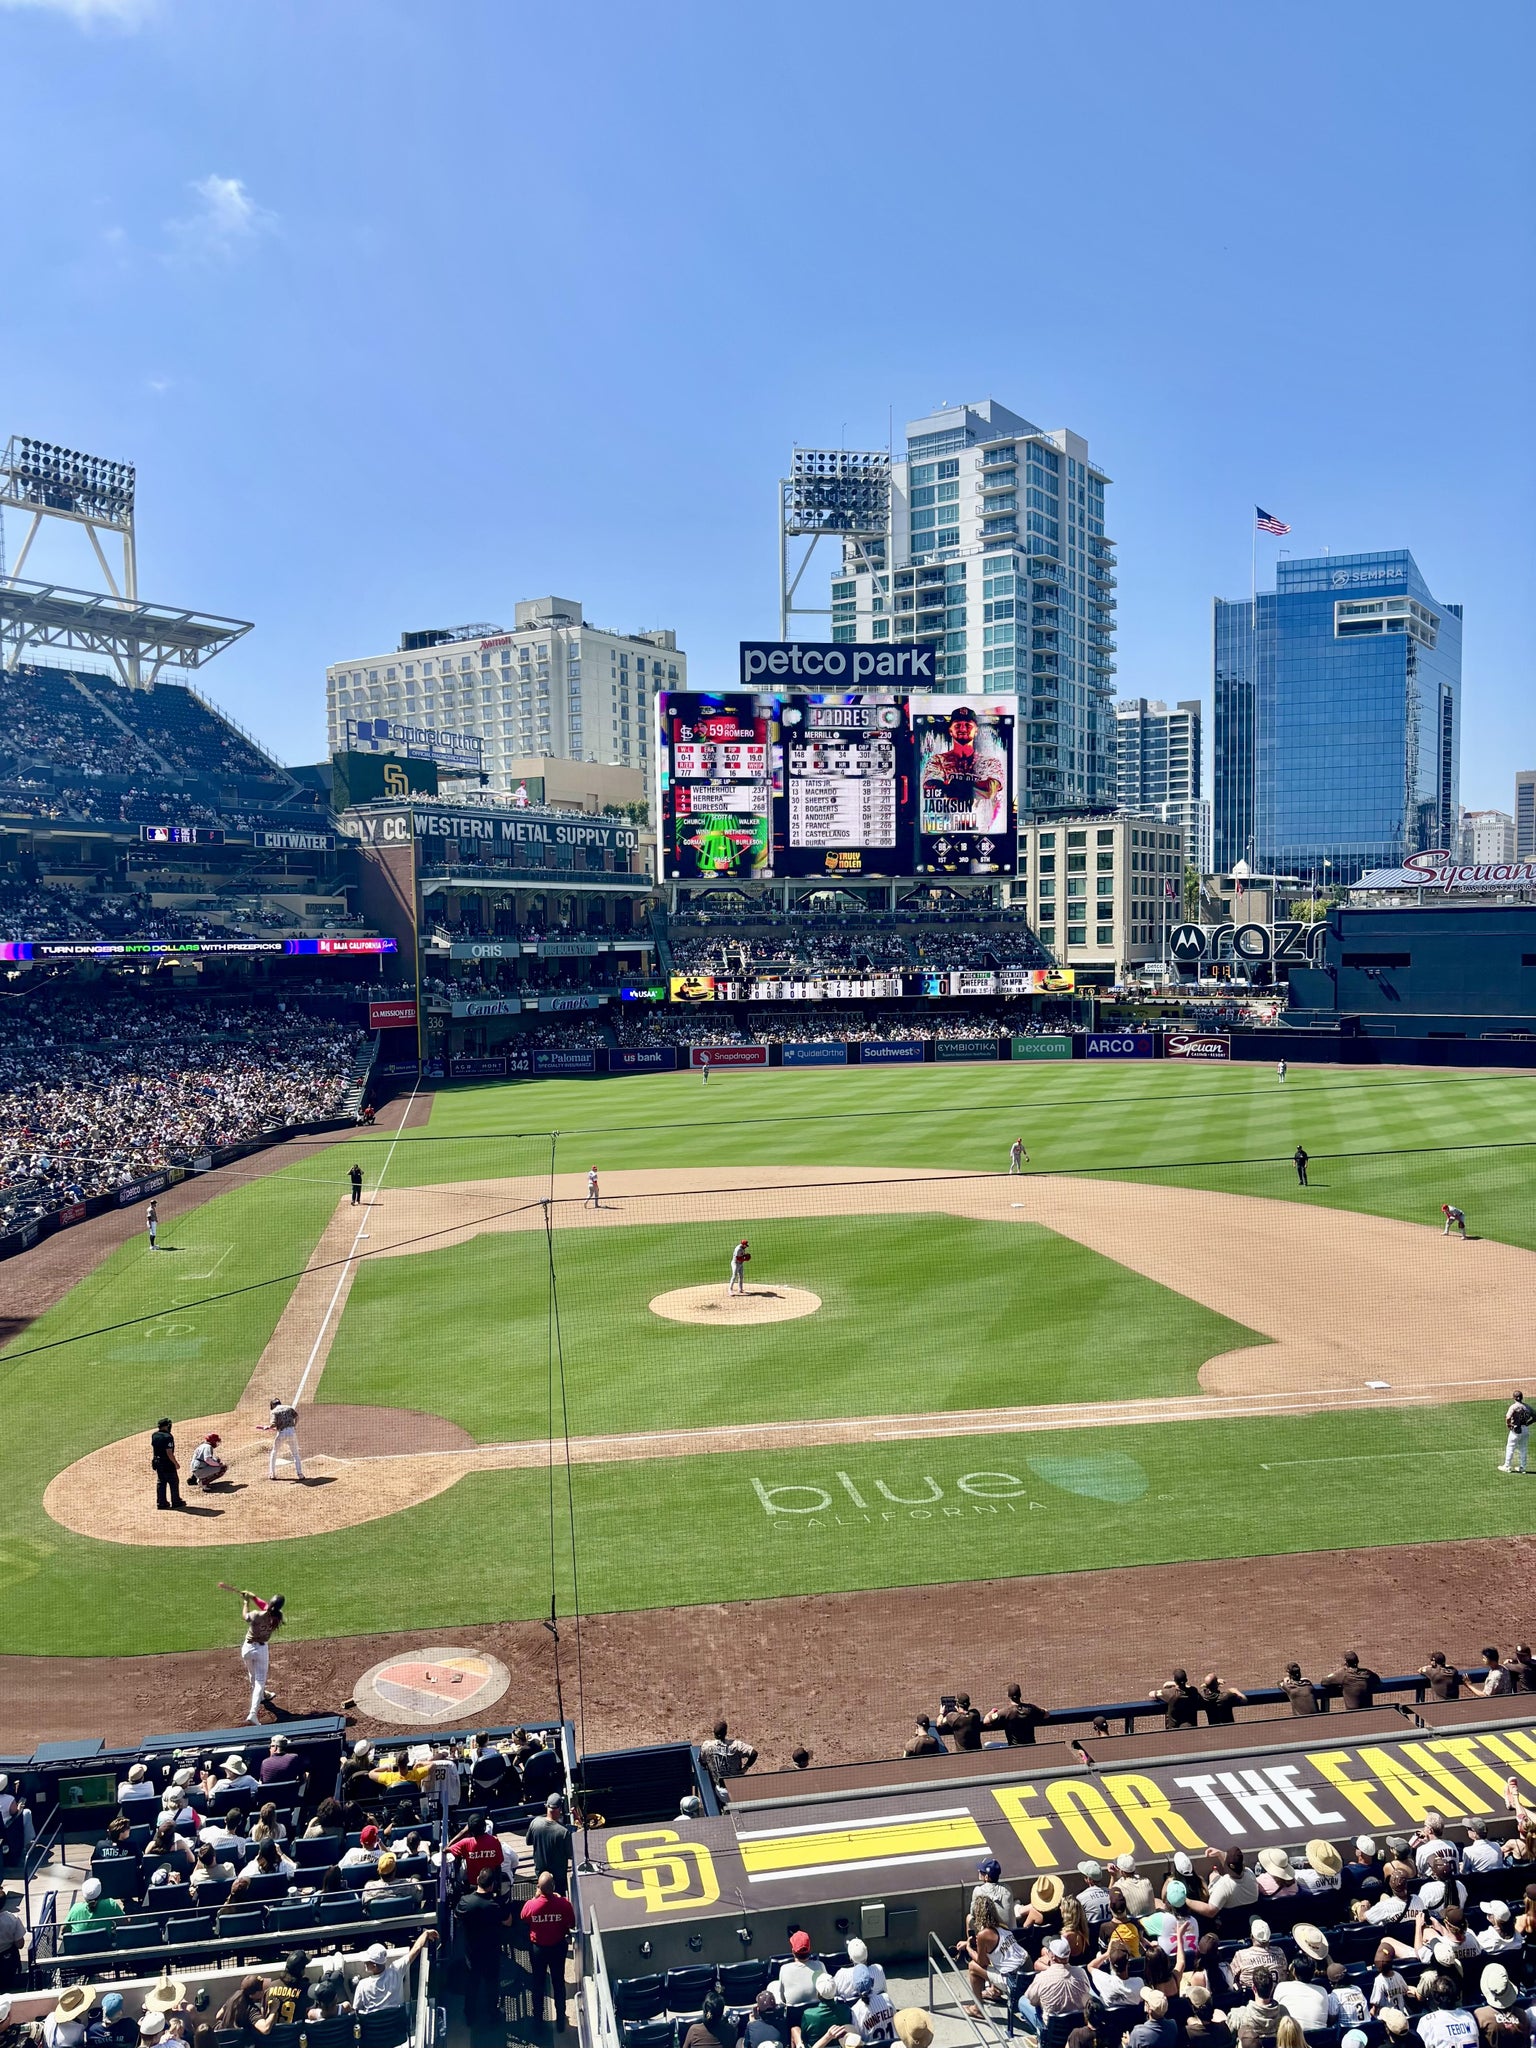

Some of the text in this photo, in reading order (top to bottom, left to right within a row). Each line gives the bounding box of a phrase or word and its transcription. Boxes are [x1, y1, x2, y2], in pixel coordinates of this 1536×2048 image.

[1352, 569, 1404, 582] SEMPRA
[744, 644, 931, 683] petco park
[815, 709, 869, 726] PADRES
[709, 724, 723, 737] 59
[393, 724, 480, 751] QuidelOrtho
[934, 789, 942, 797] CF
[923, 799, 973, 813] JACKSON
[383, 817, 410, 840] CO.
[413, 814, 638, 849] WESTERN METAL SUPPLY CO.
[264, 833, 327, 849] CUTWATER
[838, 852, 861, 860] TRULY
[838, 860, 862, 868] NOLEN
[1401, 849, 1536, 894] Sycuan
[1458, 884, 1496, 893] CASINO
[333, 942, 348, 950] BAJA
[350, 941, 381, 949] CALIFORNIA
[1211, 921, 1332, 961] razr
[41, 946, 74, 954] TURN
[152, 944, 199, 952] DOLLARS
[201, 943, 226, 951] WITH
[471, 945, 502, 957] ORIS
[923, 980, 946, 994] 2 0
[638, 990, 656, 998] USAA
[466, 1001, 509, 1016] Canel's
[551, 996, 589, 1011] Canel's
[428, 1016, 444, 1028] 336
[864, 1047, 914, 1057] Southwest
[937, 1043, 996, 1051] CYMBIOTIKA
[1088, 1040, 1134, 1053] ARCO
[1168, 1036, 1224, 1057] Sycuan
[551, 1053, 591, 1063] Palomar
[623, 1052, 662, 1062] us bank
[714, 1052, 760, 1062] Snapdragon
[797, 1049, 844, 1058] QuidelOrtho
[511, 1060, 529, 1071] 342
[150, 1177, 165, 1189] petco
[126, 1186, 141, 1198] petco
[749, 1470, 1028, 1516] blue
[773, 1501, 1048, 1530] CALIFORNIA
[435, 1768, 446, 1781] 23
[992, 1774, 1209, 1869] FOR
[1173, 1764, 1347, 1836] THE
[102, 1848, 118, 1857] TATIS
[468, 1850, 496, 1860] ELITE
[605, 1829, 721, 1914] SD
[531, 1913, 562, 1923] ELITE
[268, 1985, 301, 1998] PADDACK
[1356, 2003, 1365, 2021] 3
[1446, 2023, 1471, 2037] TEBOW
